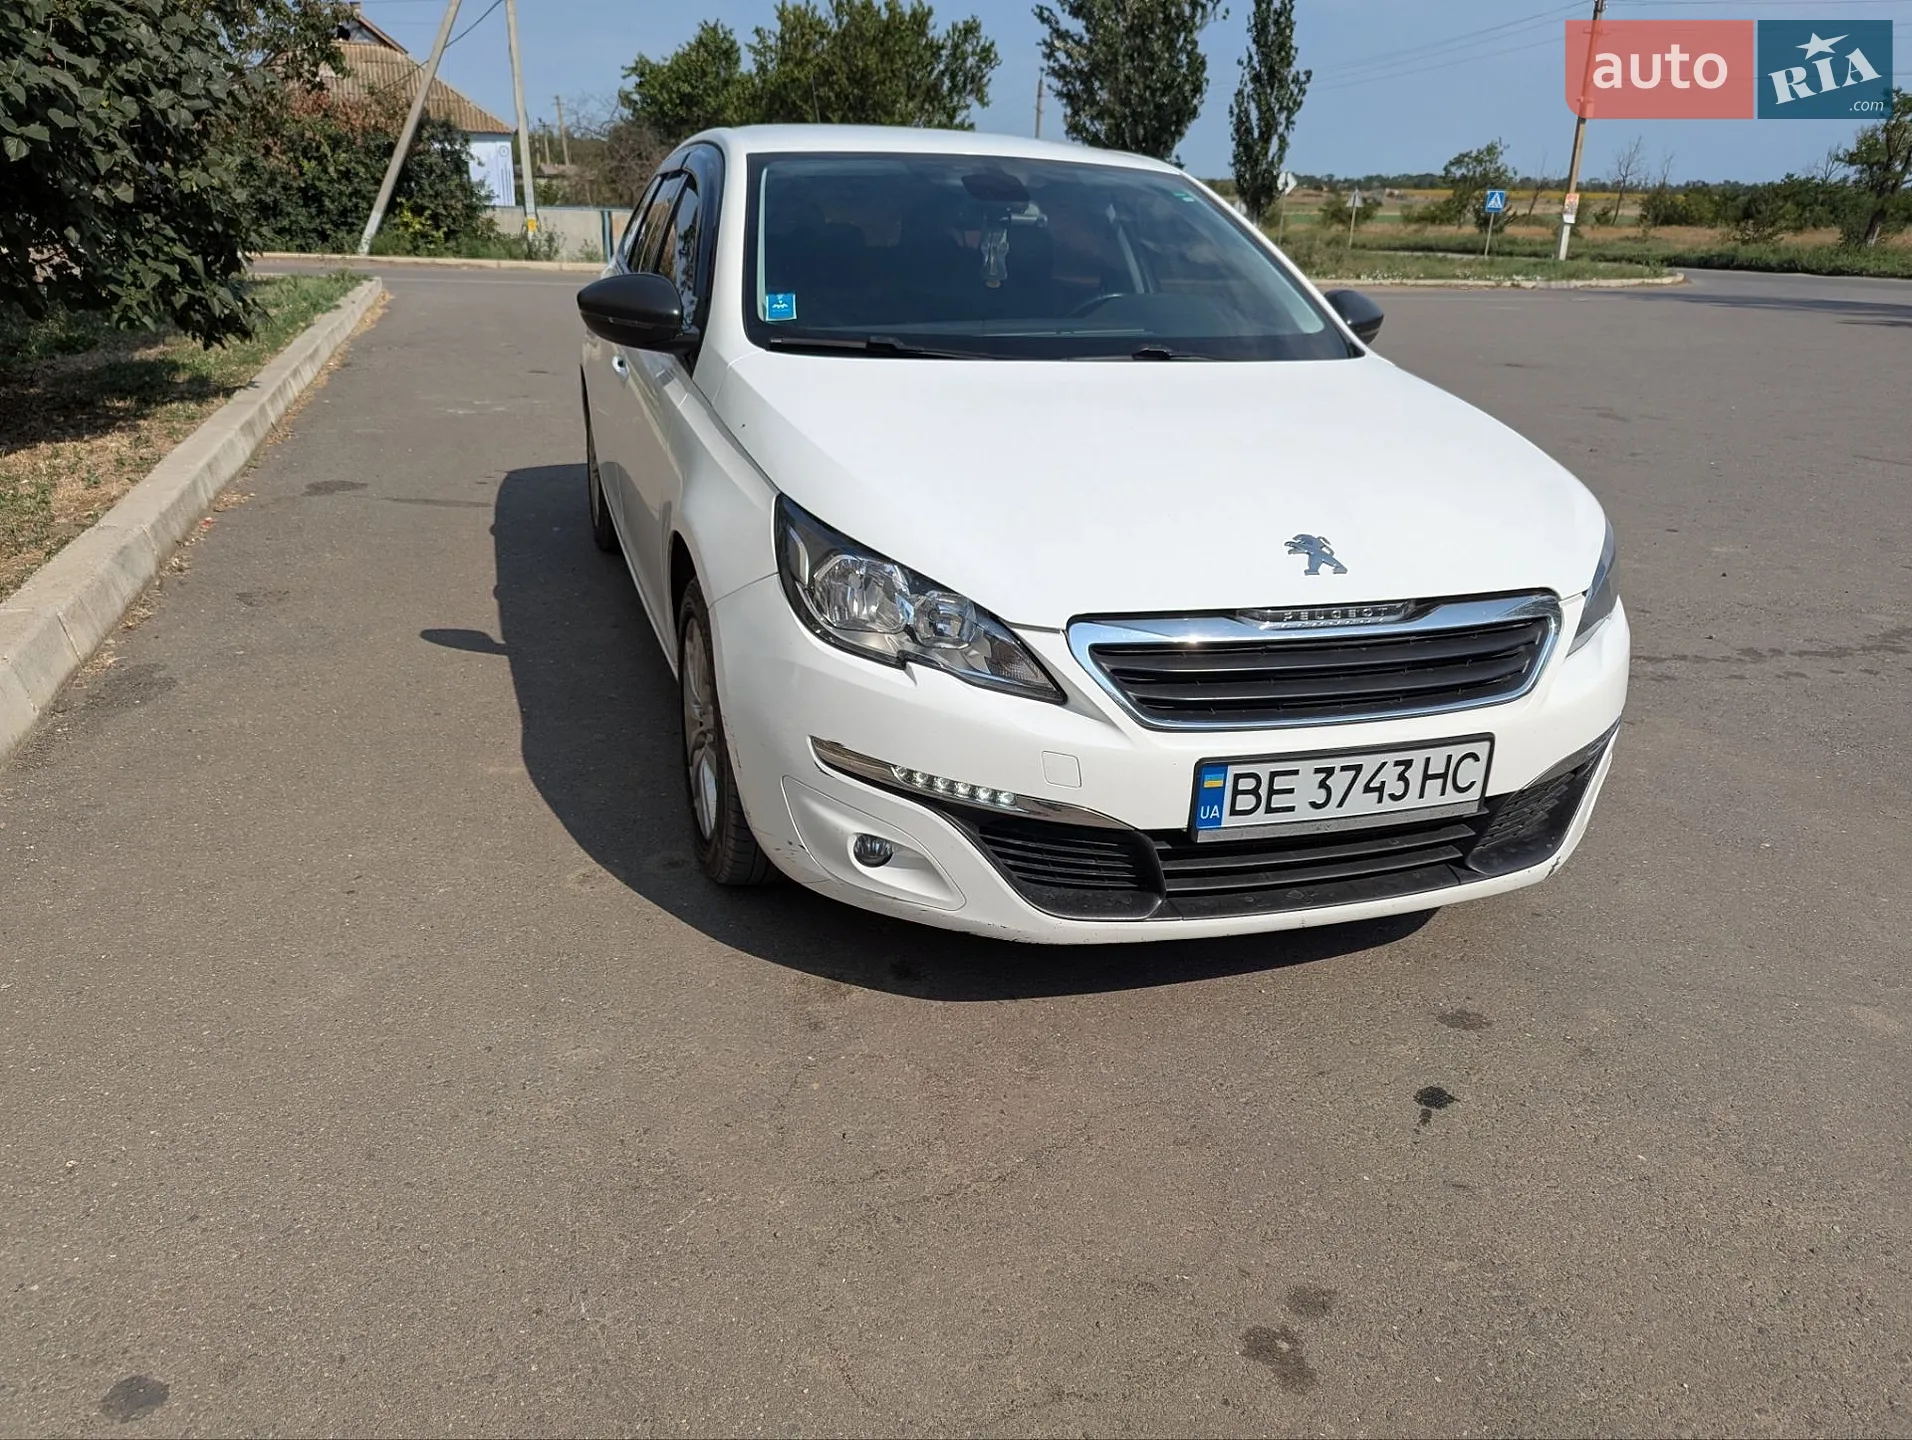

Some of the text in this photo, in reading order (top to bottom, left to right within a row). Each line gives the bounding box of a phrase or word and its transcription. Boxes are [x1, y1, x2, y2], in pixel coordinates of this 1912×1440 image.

[1229, 752, 1481, 817] BE 3743 HC
[1200, 804, 1220, 820] UA
